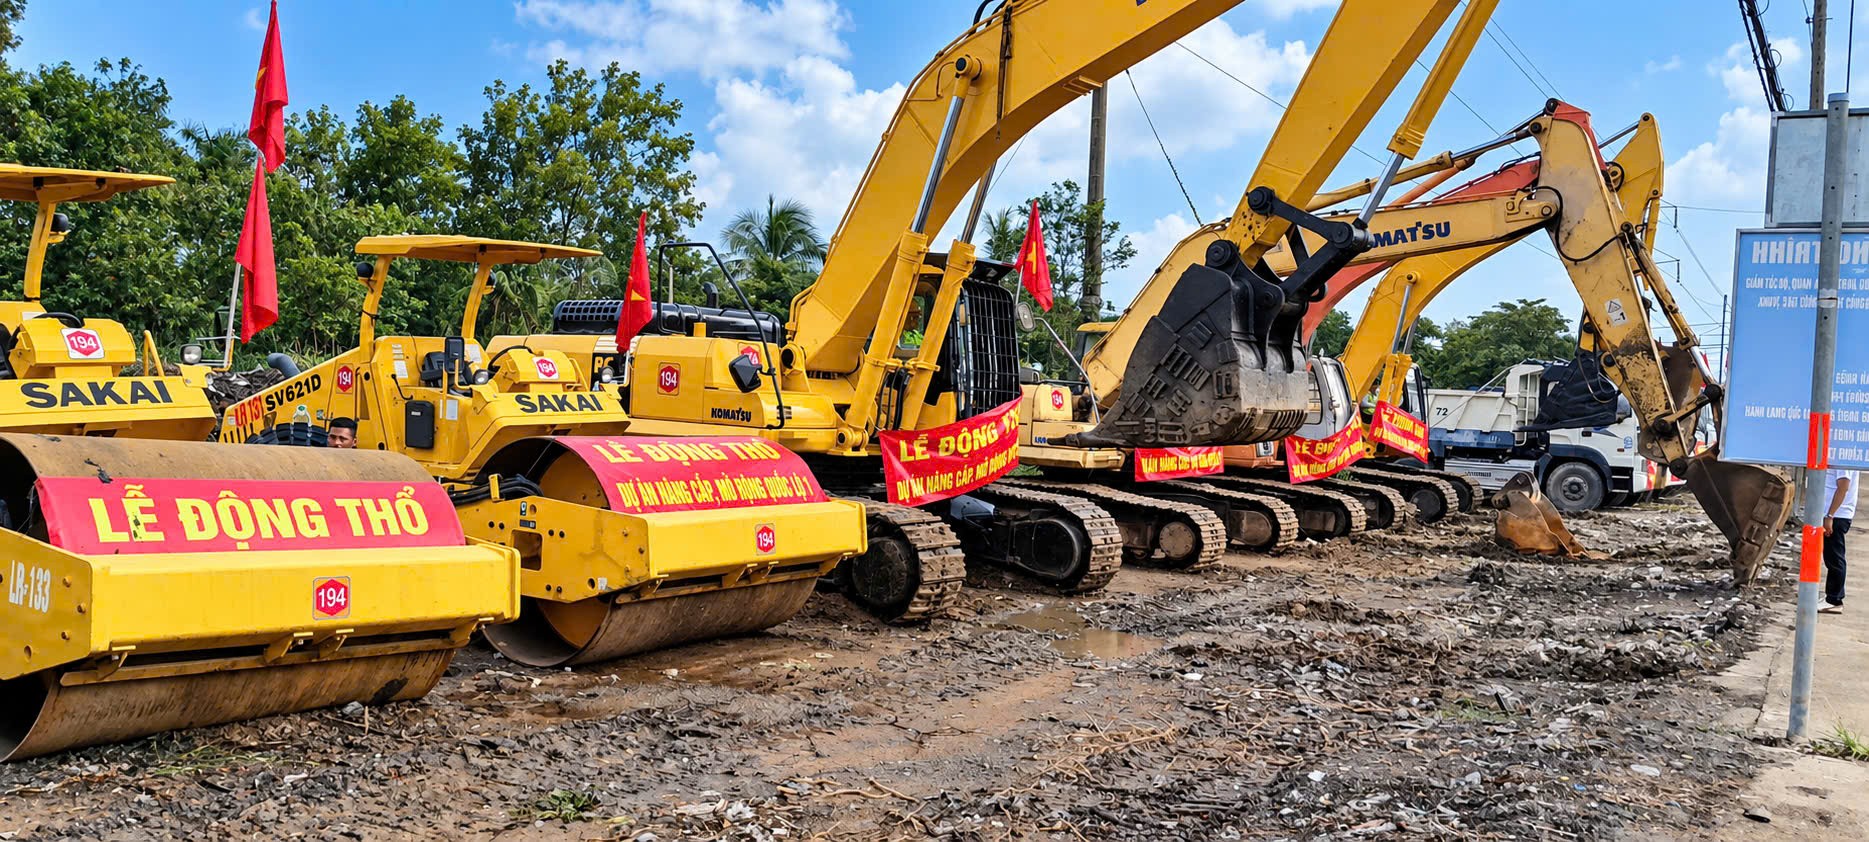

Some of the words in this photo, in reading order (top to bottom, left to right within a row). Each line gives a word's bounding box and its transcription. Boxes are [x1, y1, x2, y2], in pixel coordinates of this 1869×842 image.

[1373, 221, 1451, 249] MATSU
[70, 335, 97, 350] 194
[538, 361, 555, 373] 194
[338, 370, 352, 385] 194
[660, 370, 678, 387] 194
[20, 380, 174, 409] SAKAI
[265, 374, 321, 412] SV621D
[514, 394, 605, 414] SAKAI
[1436, 407, 1449, 416] 72
[711, 407, 752, 423] KOMATSU
[899, 434, 930, 462] LỄ
[939, 421, 999, 458] ĐỘNG
[637, 440, 729, 466] ĐỘNG
[88, 484, 165, 543] LỄ
[175, 490, 330, 551] ĐỘNG
[336, 486, 429, 538] THỔ
[758, 532, 774, 547] 194
[317, 586, 346, 611] 194
